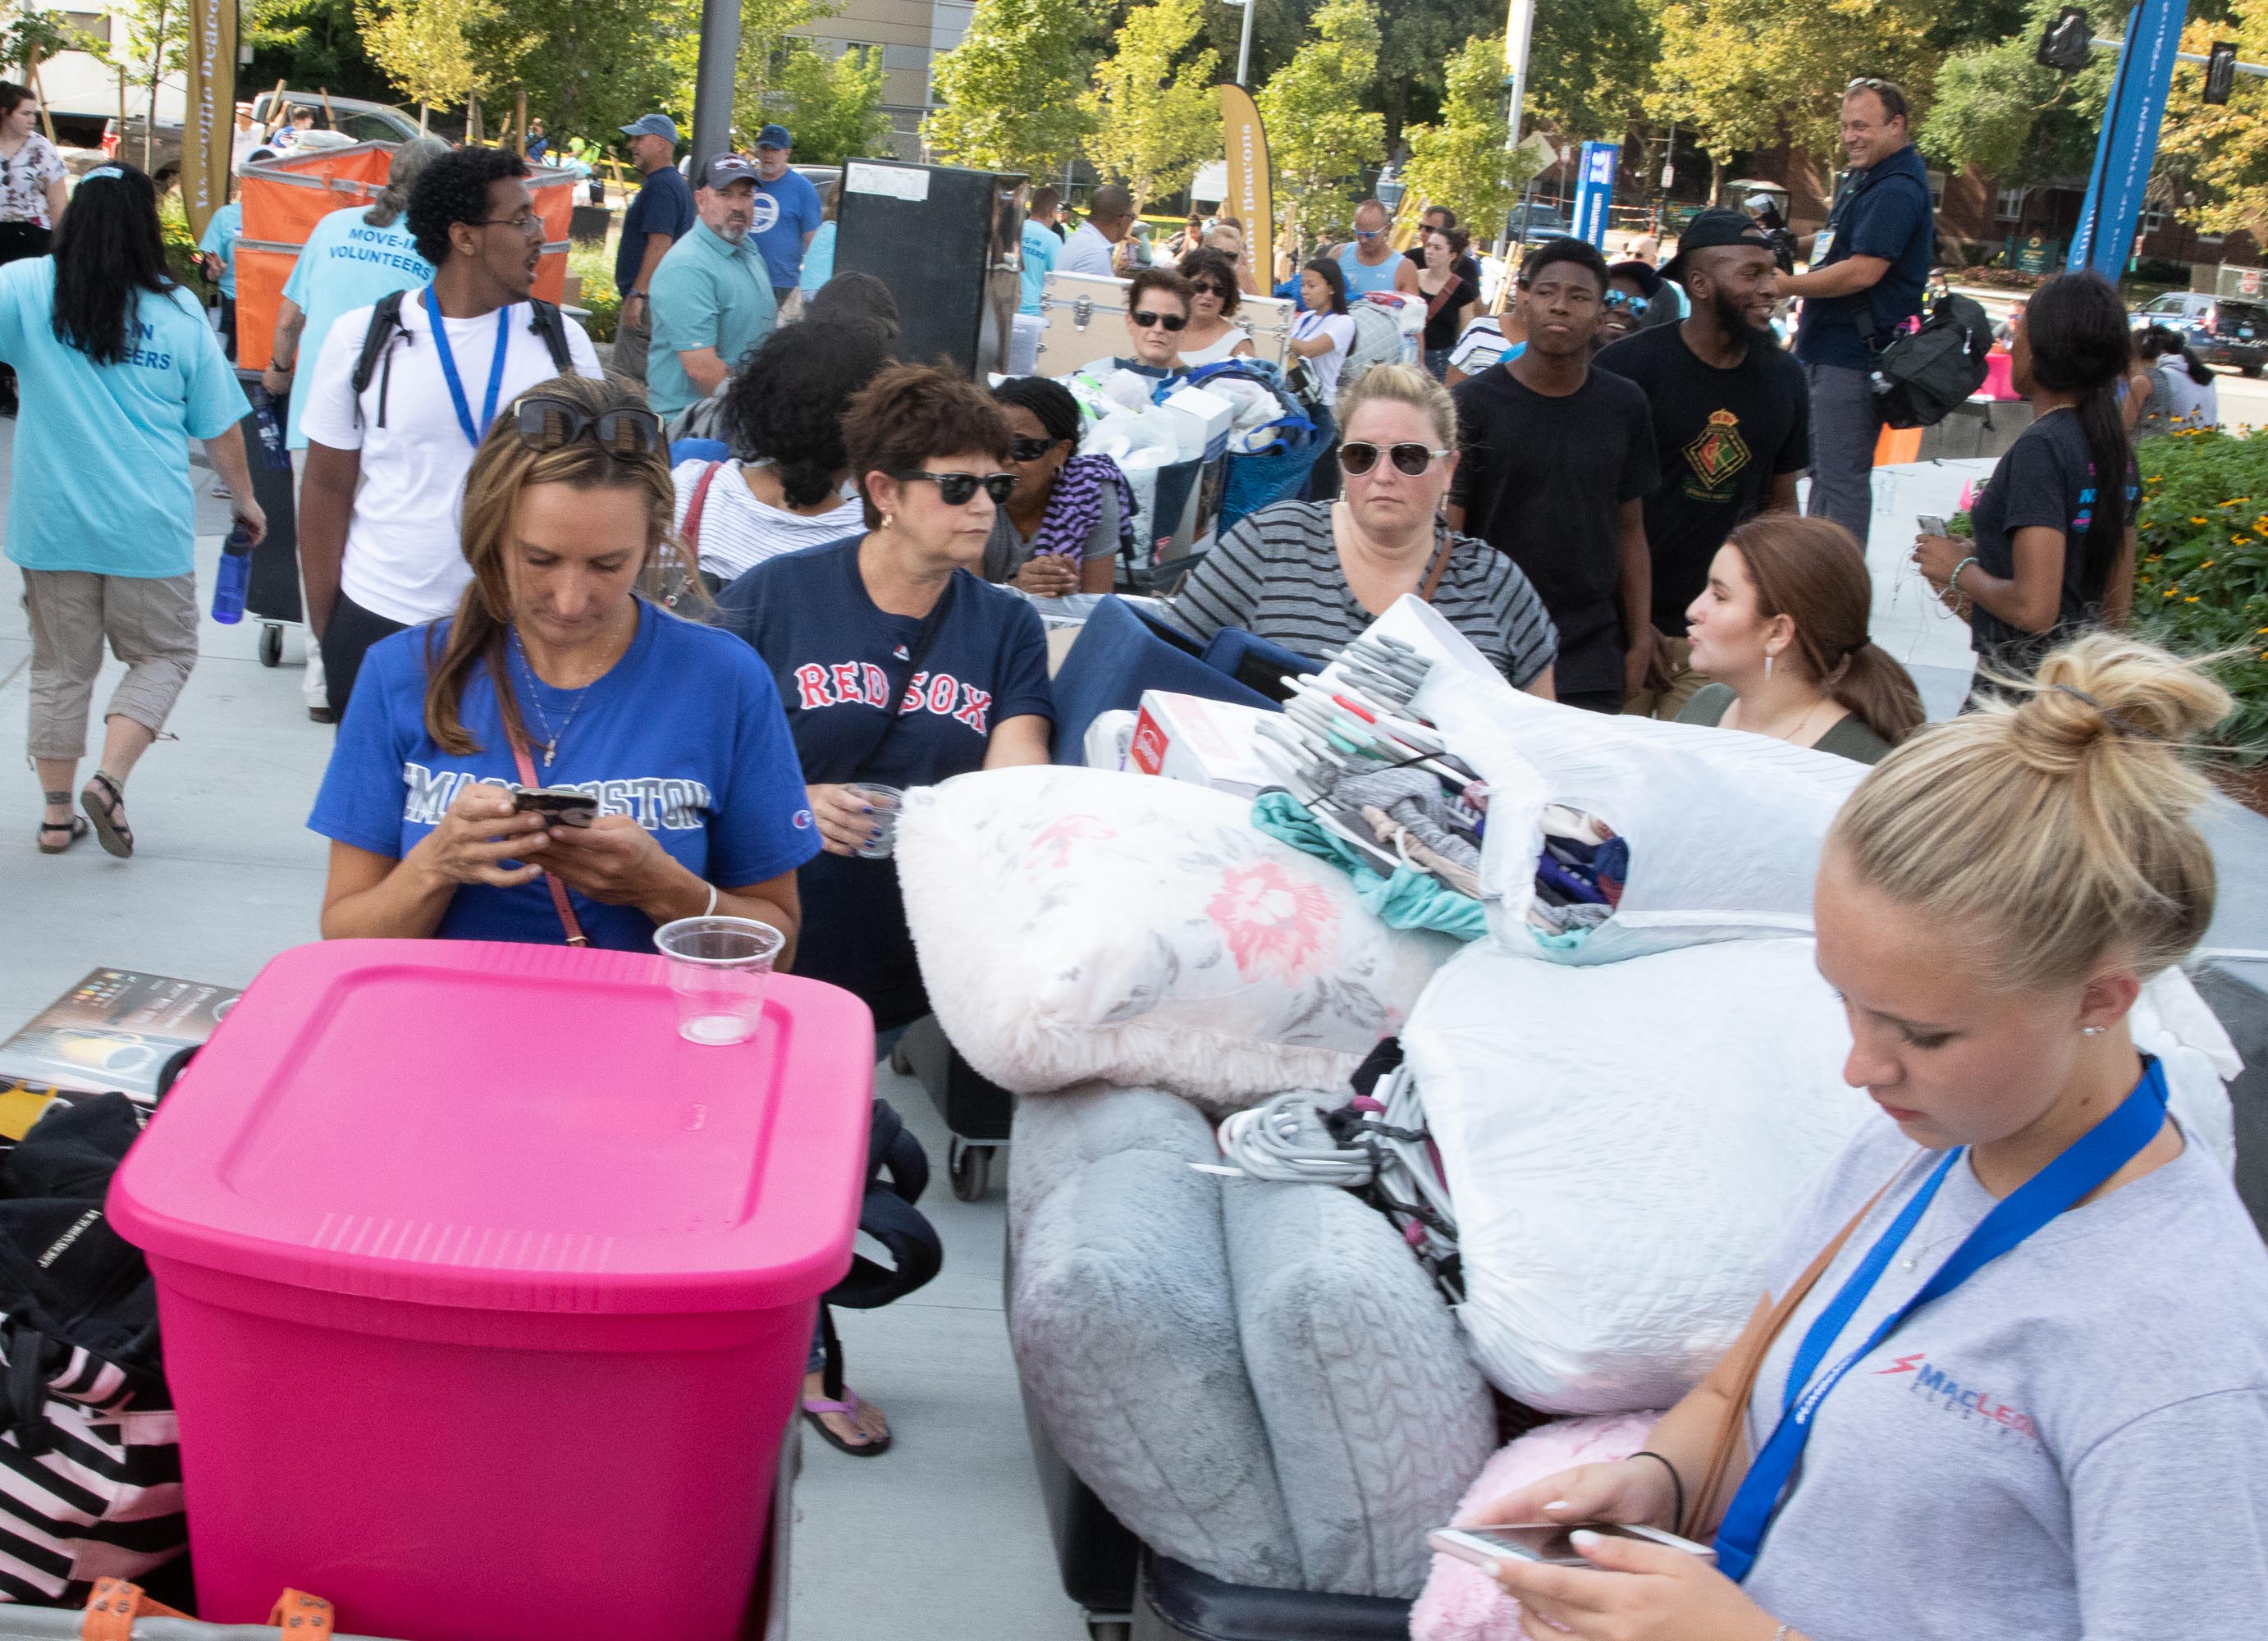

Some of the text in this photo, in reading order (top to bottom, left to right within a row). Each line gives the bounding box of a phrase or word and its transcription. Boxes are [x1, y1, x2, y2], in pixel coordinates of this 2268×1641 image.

[1241, 124, 1255, 211] Beacons
[329, 245, 432, 281] VOLUNTEERS
[793, 661, 993, 735] RED SOX
